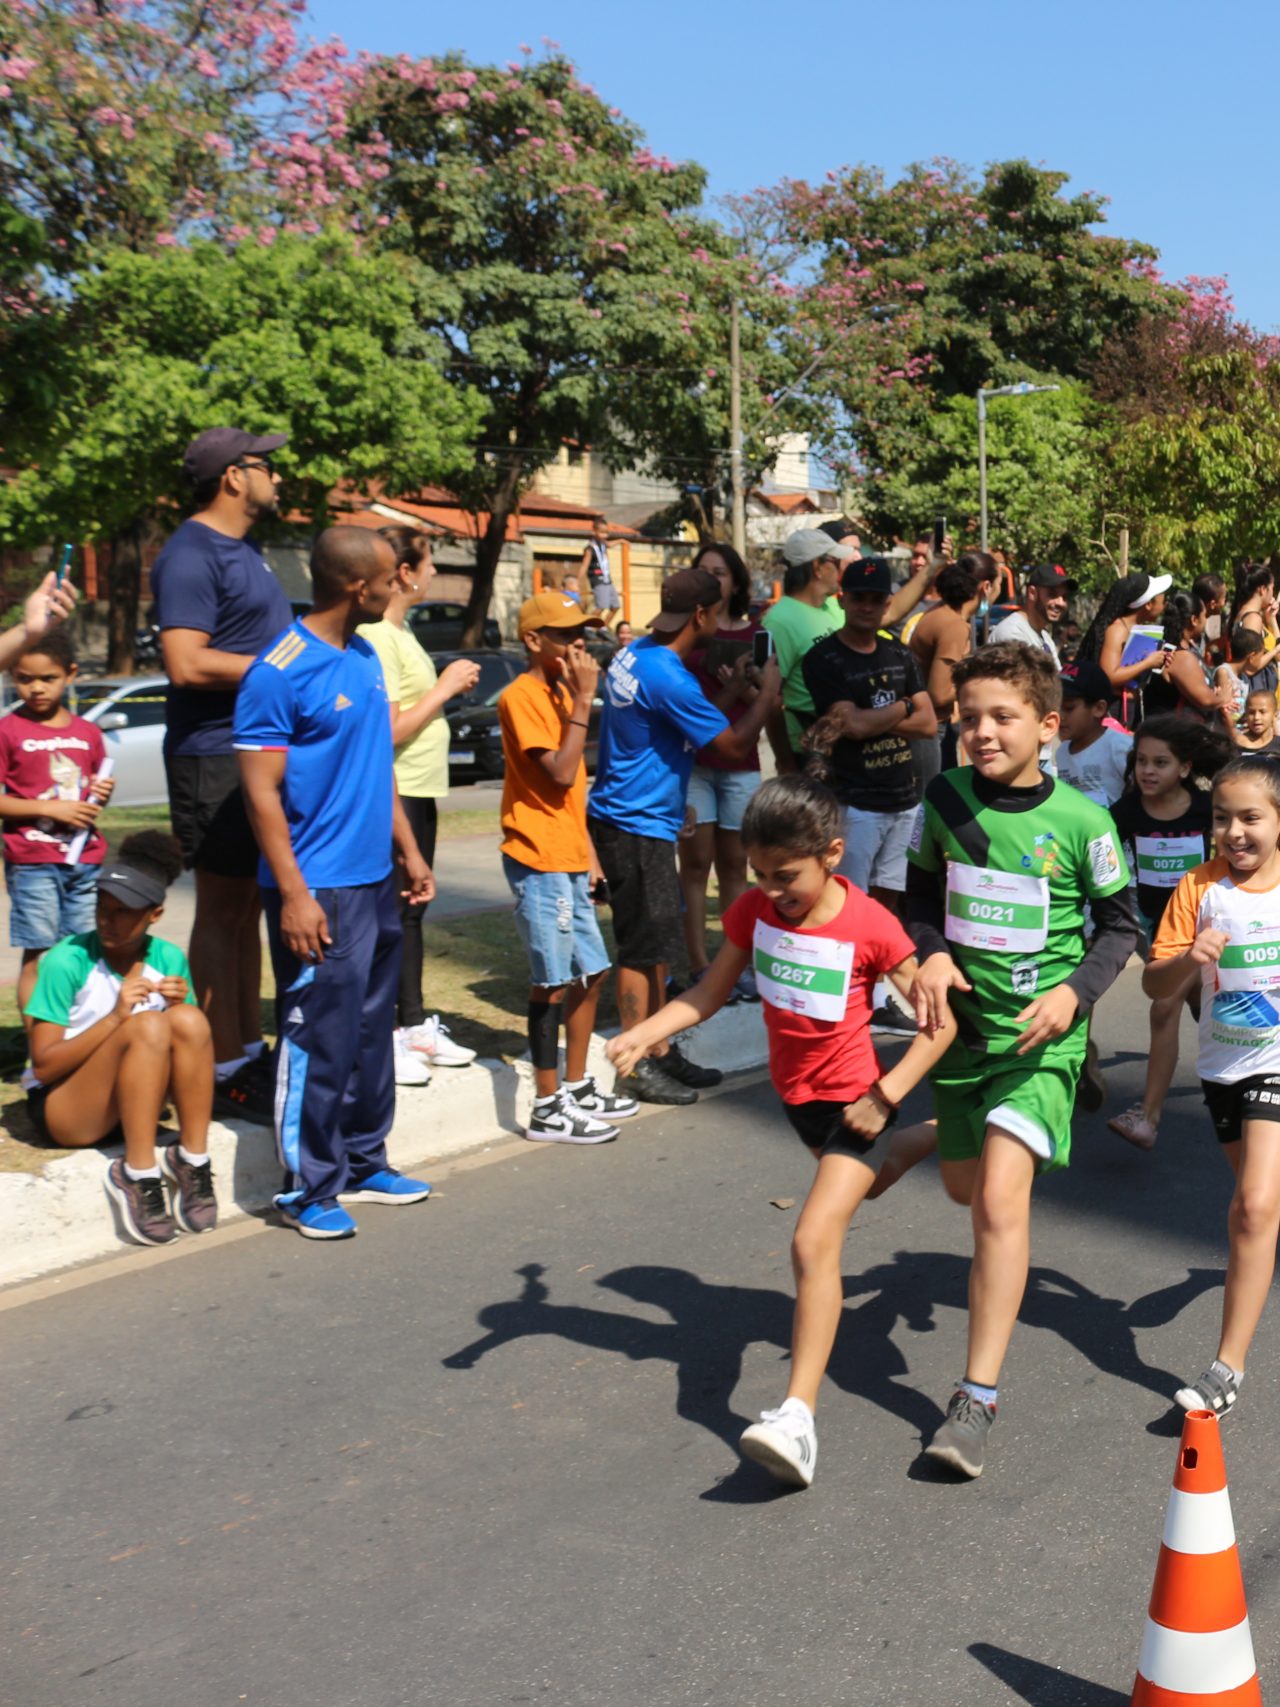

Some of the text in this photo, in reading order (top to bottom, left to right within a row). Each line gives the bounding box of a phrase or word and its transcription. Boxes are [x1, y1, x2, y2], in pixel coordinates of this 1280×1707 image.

[865, 754, 891, 769] MAIS
[1153, 858, 1185, 869] 0072
[968, 901, 1015, 923] 0021
[770, 961, 817, 986] 0267
